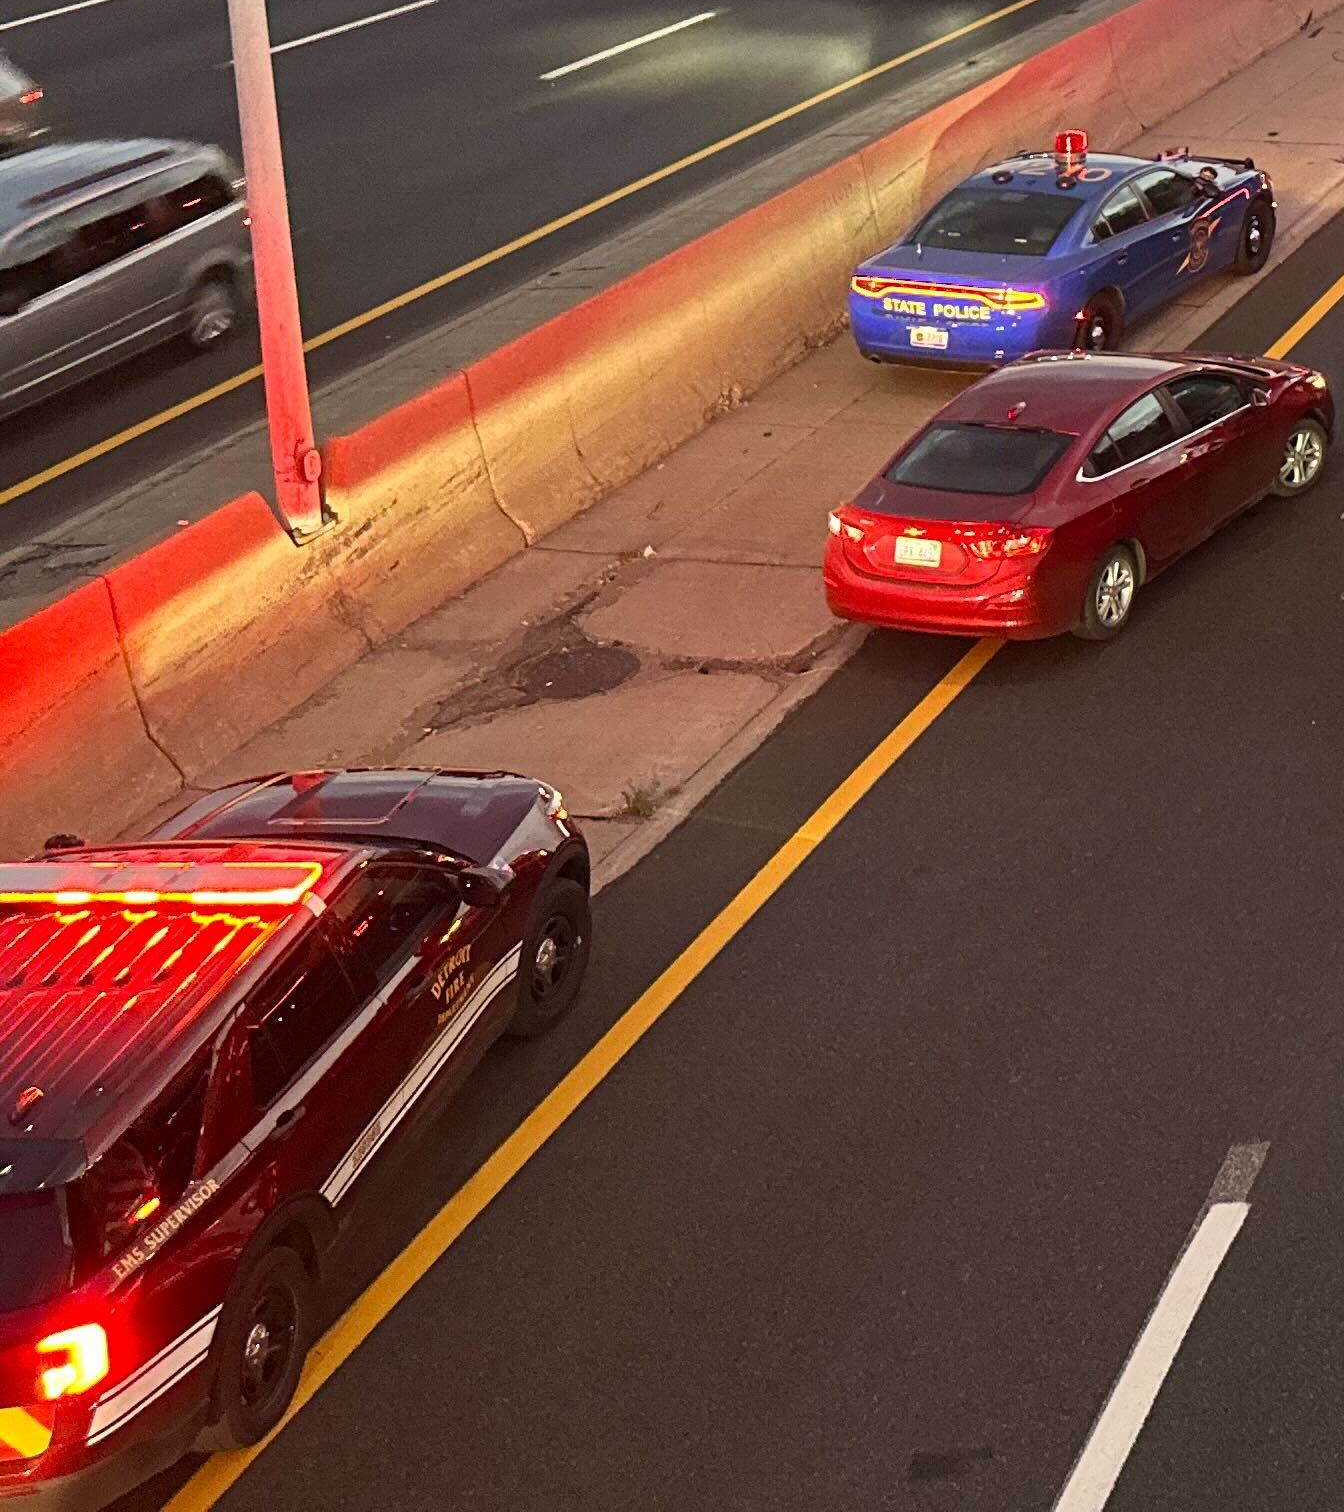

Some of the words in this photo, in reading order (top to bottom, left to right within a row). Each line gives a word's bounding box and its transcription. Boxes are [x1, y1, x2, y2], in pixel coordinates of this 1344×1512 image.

[883, 297, 926, 316] STATE
[933, 303, 991, 320] POLICE
[430, 943, 472, 1001] DETROIT
[445, 970, 465, 1005] FIRE
[112, 1246, 145, 1280] EMS
[143, 1178, 221, 1251] SUPERVISOR
